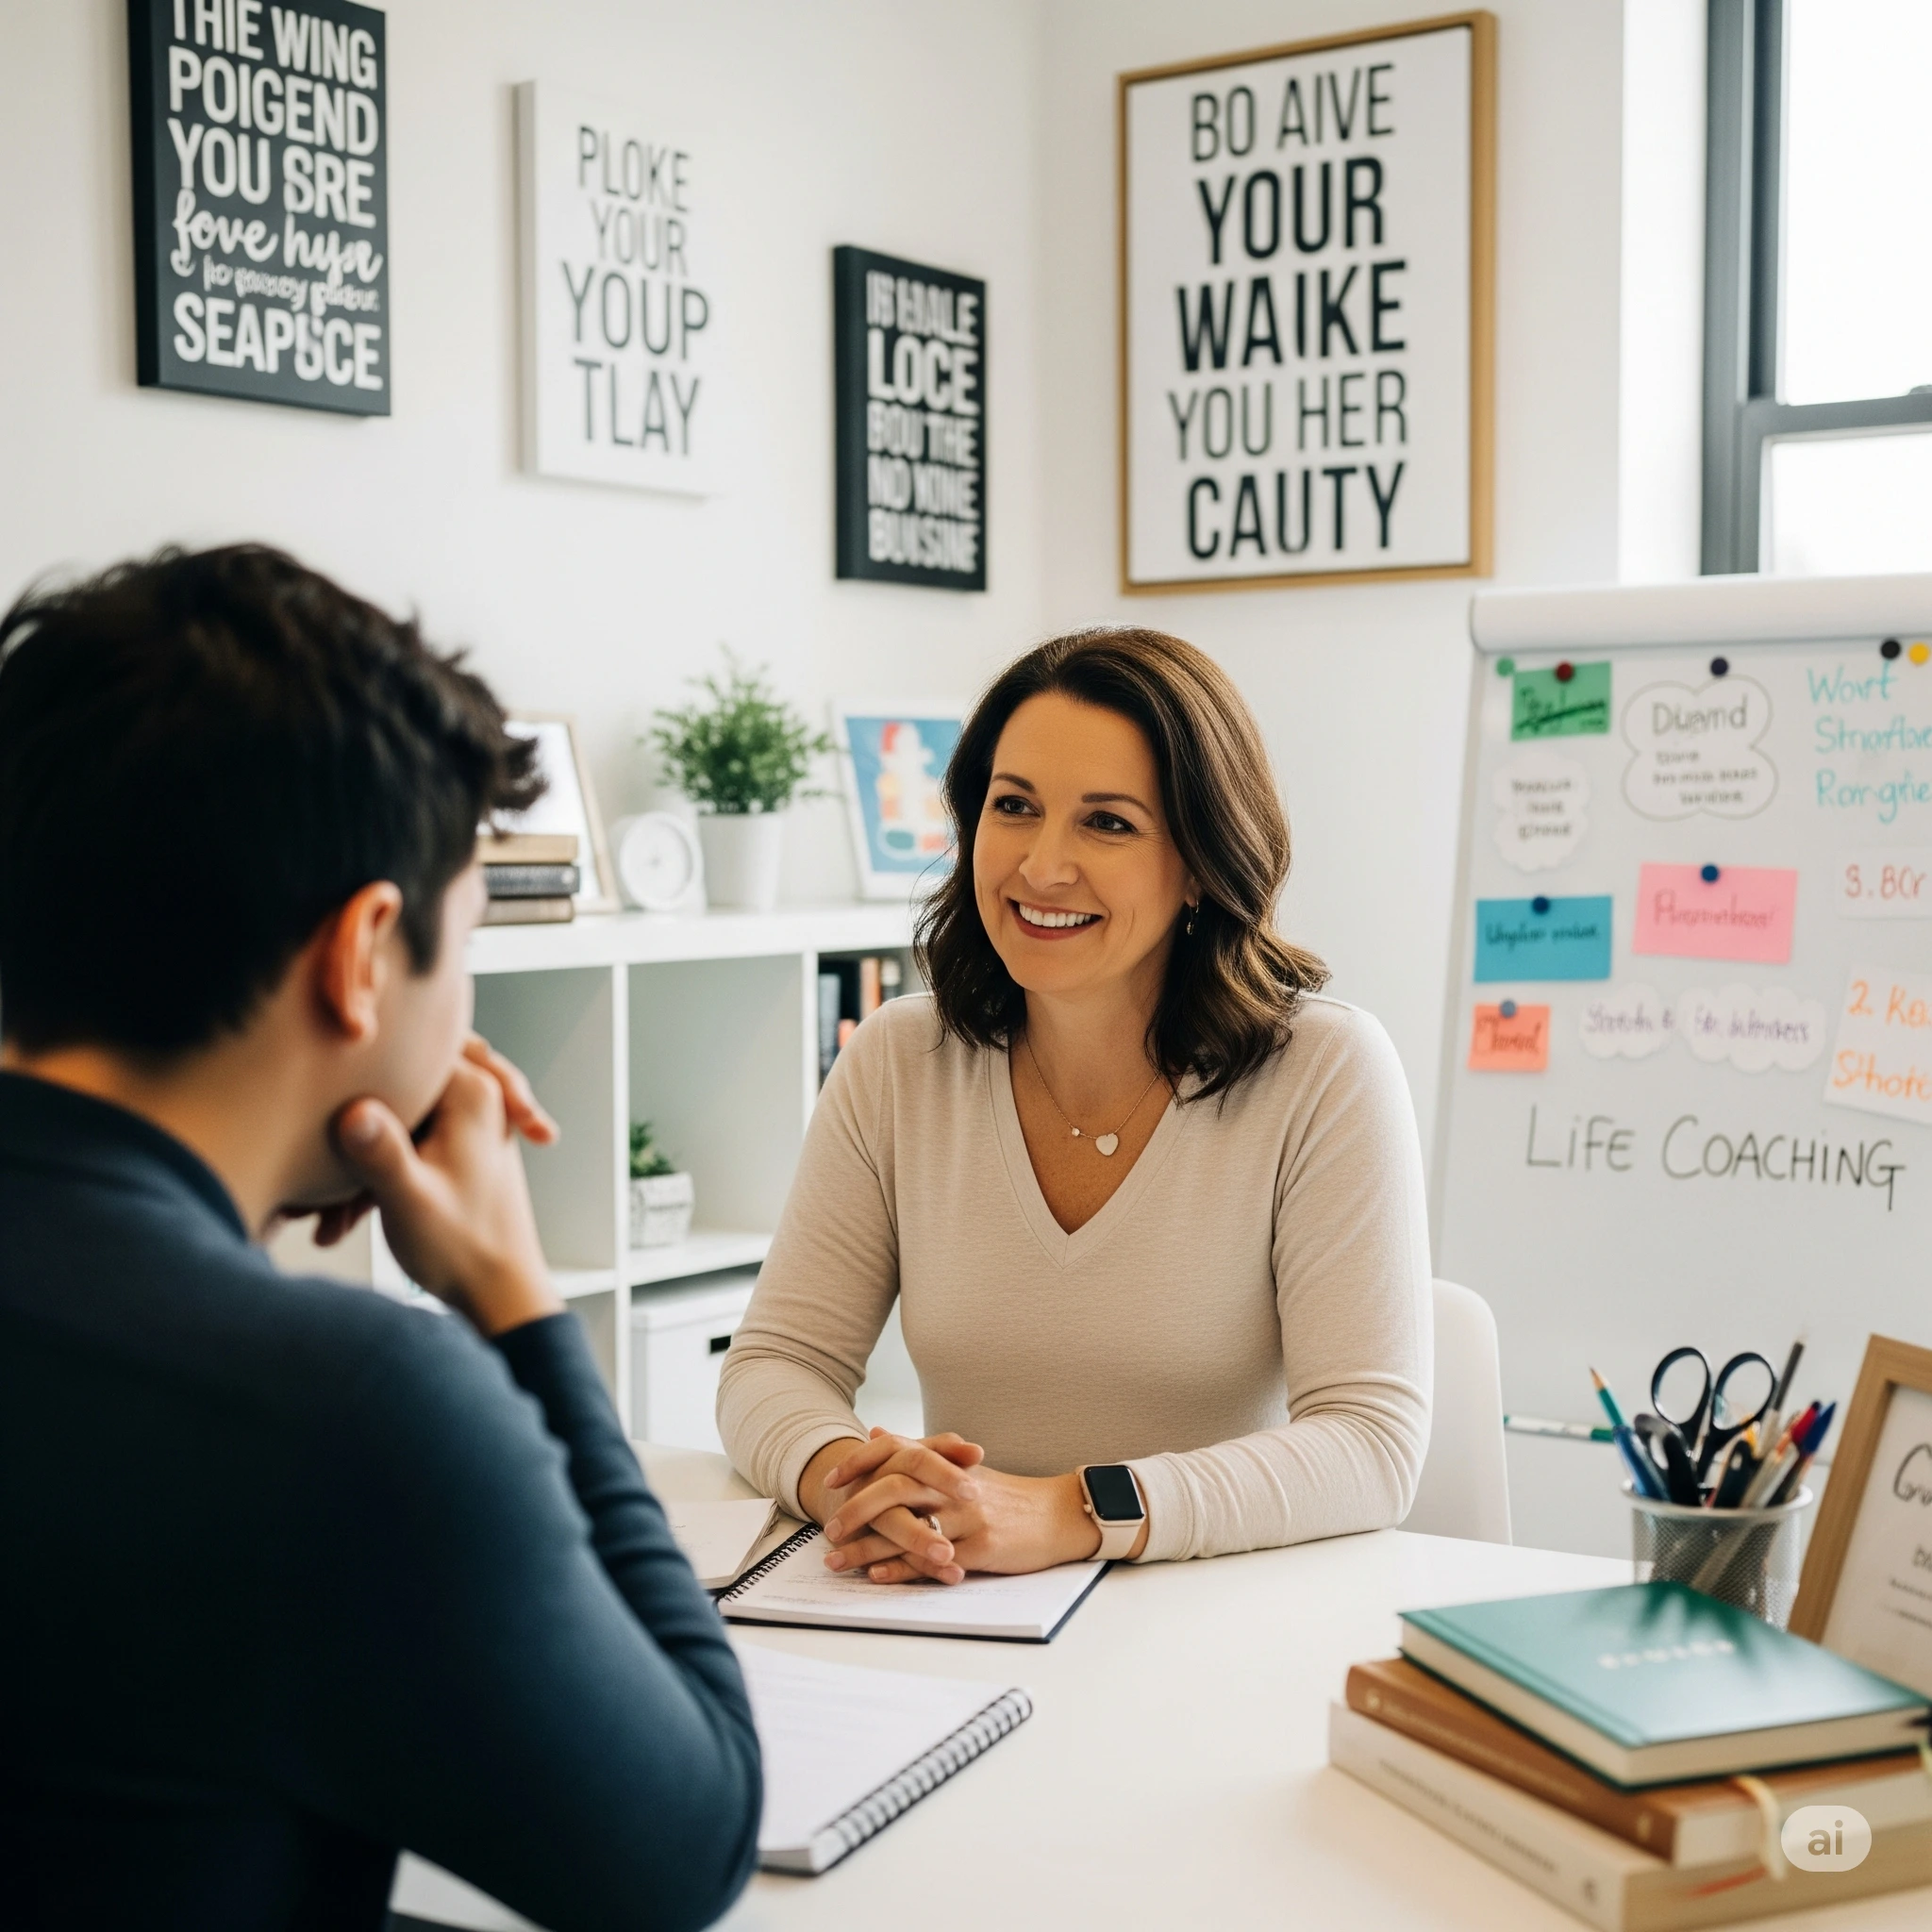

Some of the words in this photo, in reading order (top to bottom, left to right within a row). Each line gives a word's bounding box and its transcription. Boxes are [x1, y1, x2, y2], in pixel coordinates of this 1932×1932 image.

[271, 6, 377, 90] WING
[169, 45, 378, 156] POIGEND
[1192, 86, 1255, 162] BO
[1276, 62, 1395, 149] AIVE
[167, 118, 271, 204] YOU
[578, 125, 690, 212] PLOKE
[591, 199, 688, 276] YOUR
[1197, 157, 1384, 264] YOUR
[562, 261, 709, 360] YOUP
[1177, 260, 1406, 373] WAIKE
[573, 358, 700, 456] TLAY
[868, 328, 979, 416] LOCE
[1168, 383, 1272, 462] YOU
[1298, 371, 1407, 451] HER
[1188, 461, 1405, 559] CAUTY
